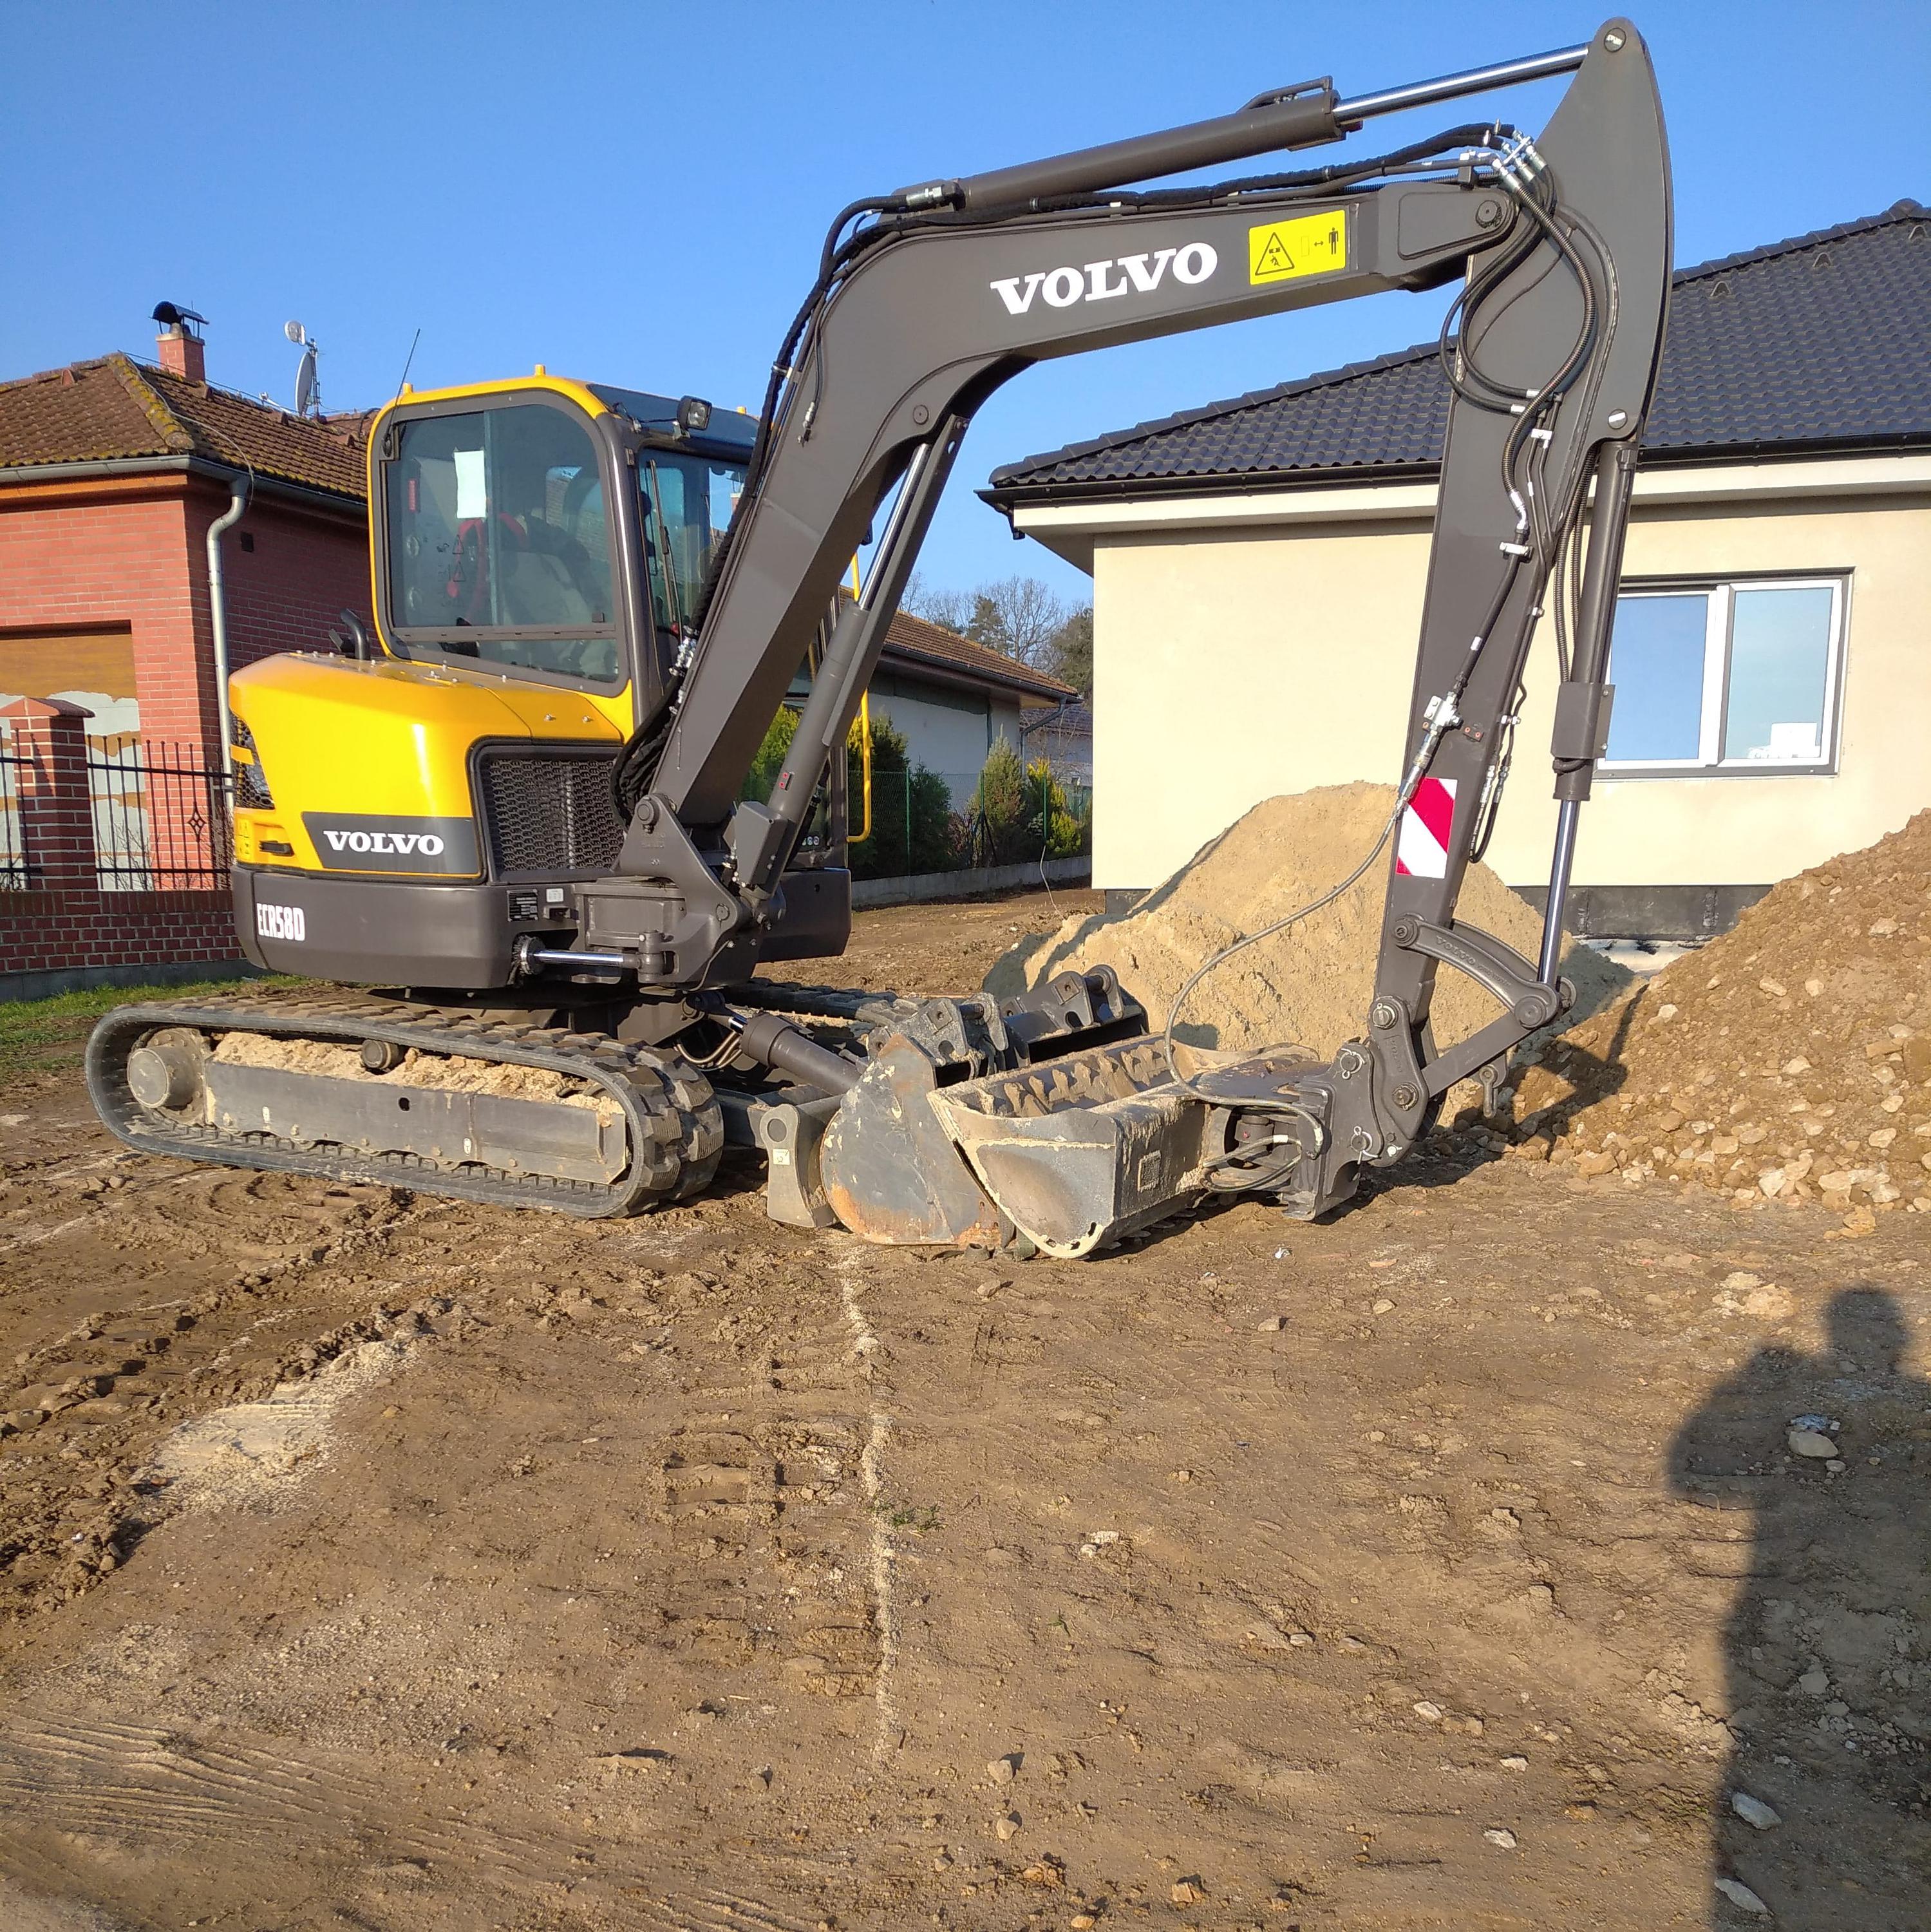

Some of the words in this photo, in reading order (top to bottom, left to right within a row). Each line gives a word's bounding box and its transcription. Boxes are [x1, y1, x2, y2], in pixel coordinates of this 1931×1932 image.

[990, 242, 1218, 315] VOLVO
[323, 831, 444, 855] VOLVO
[256, 903, 305, 942] ECR58D
[1436, 935, 1476, 965] VOLVO
